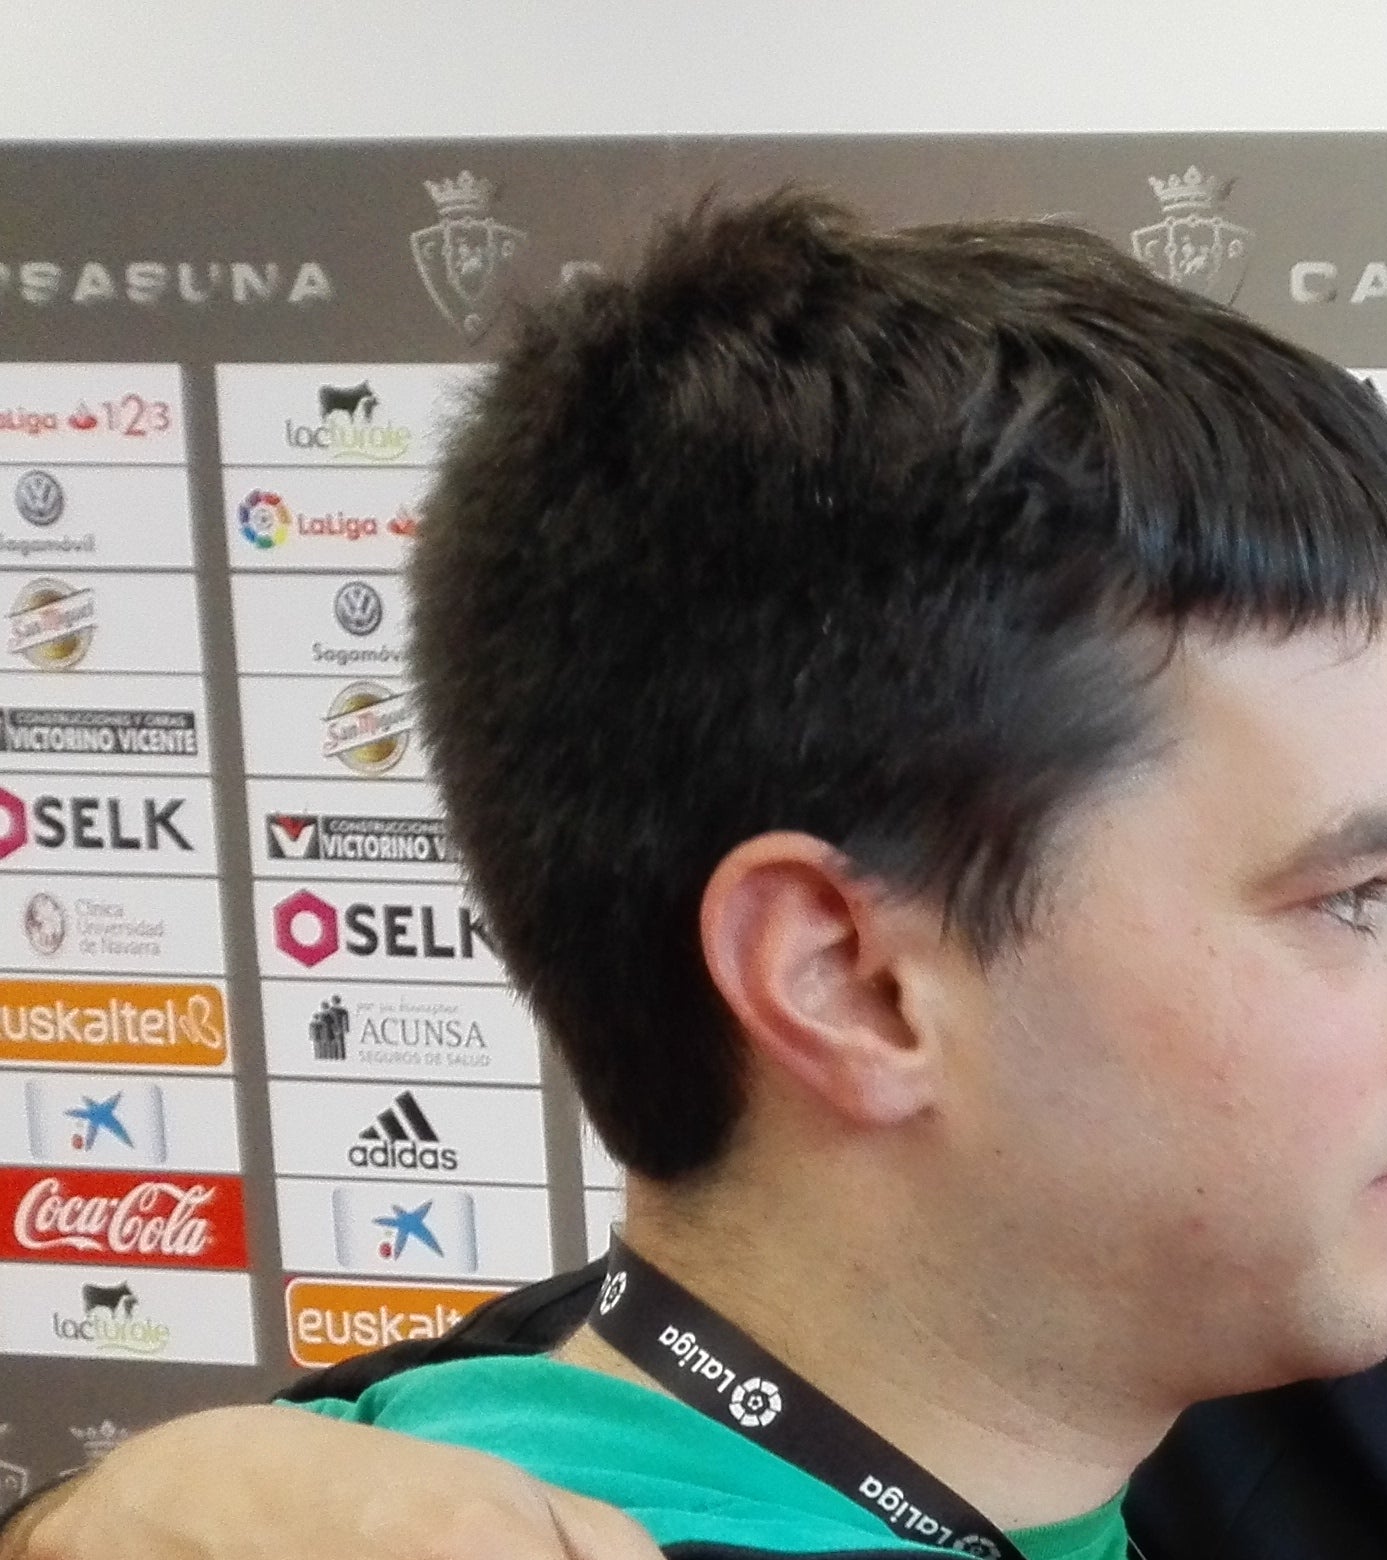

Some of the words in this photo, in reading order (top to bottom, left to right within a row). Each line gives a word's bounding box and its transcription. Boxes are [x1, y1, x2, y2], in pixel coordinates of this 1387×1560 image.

[0, 261, 337, 304] SASUNA
[299, 510, 379, 540] LaLiga
[117, 727, 197, 753] VICENTE
[33, 796, 196, 852] SELK
[321, 833, 431, 861] VICTORINO
[0, 999, 177, 1047] uskaltel
[360, 1017, 488, 1049] ACUNSA
[347, 1144, 459, 1171] adidas
[13, 1177, 217, 1257] Coca-Cola
[52, 1311, 170, 1343] lacturale
[657, 1323, 737, 1395] LaLiga
[857, 1473, 955, 1548] LaLiga
